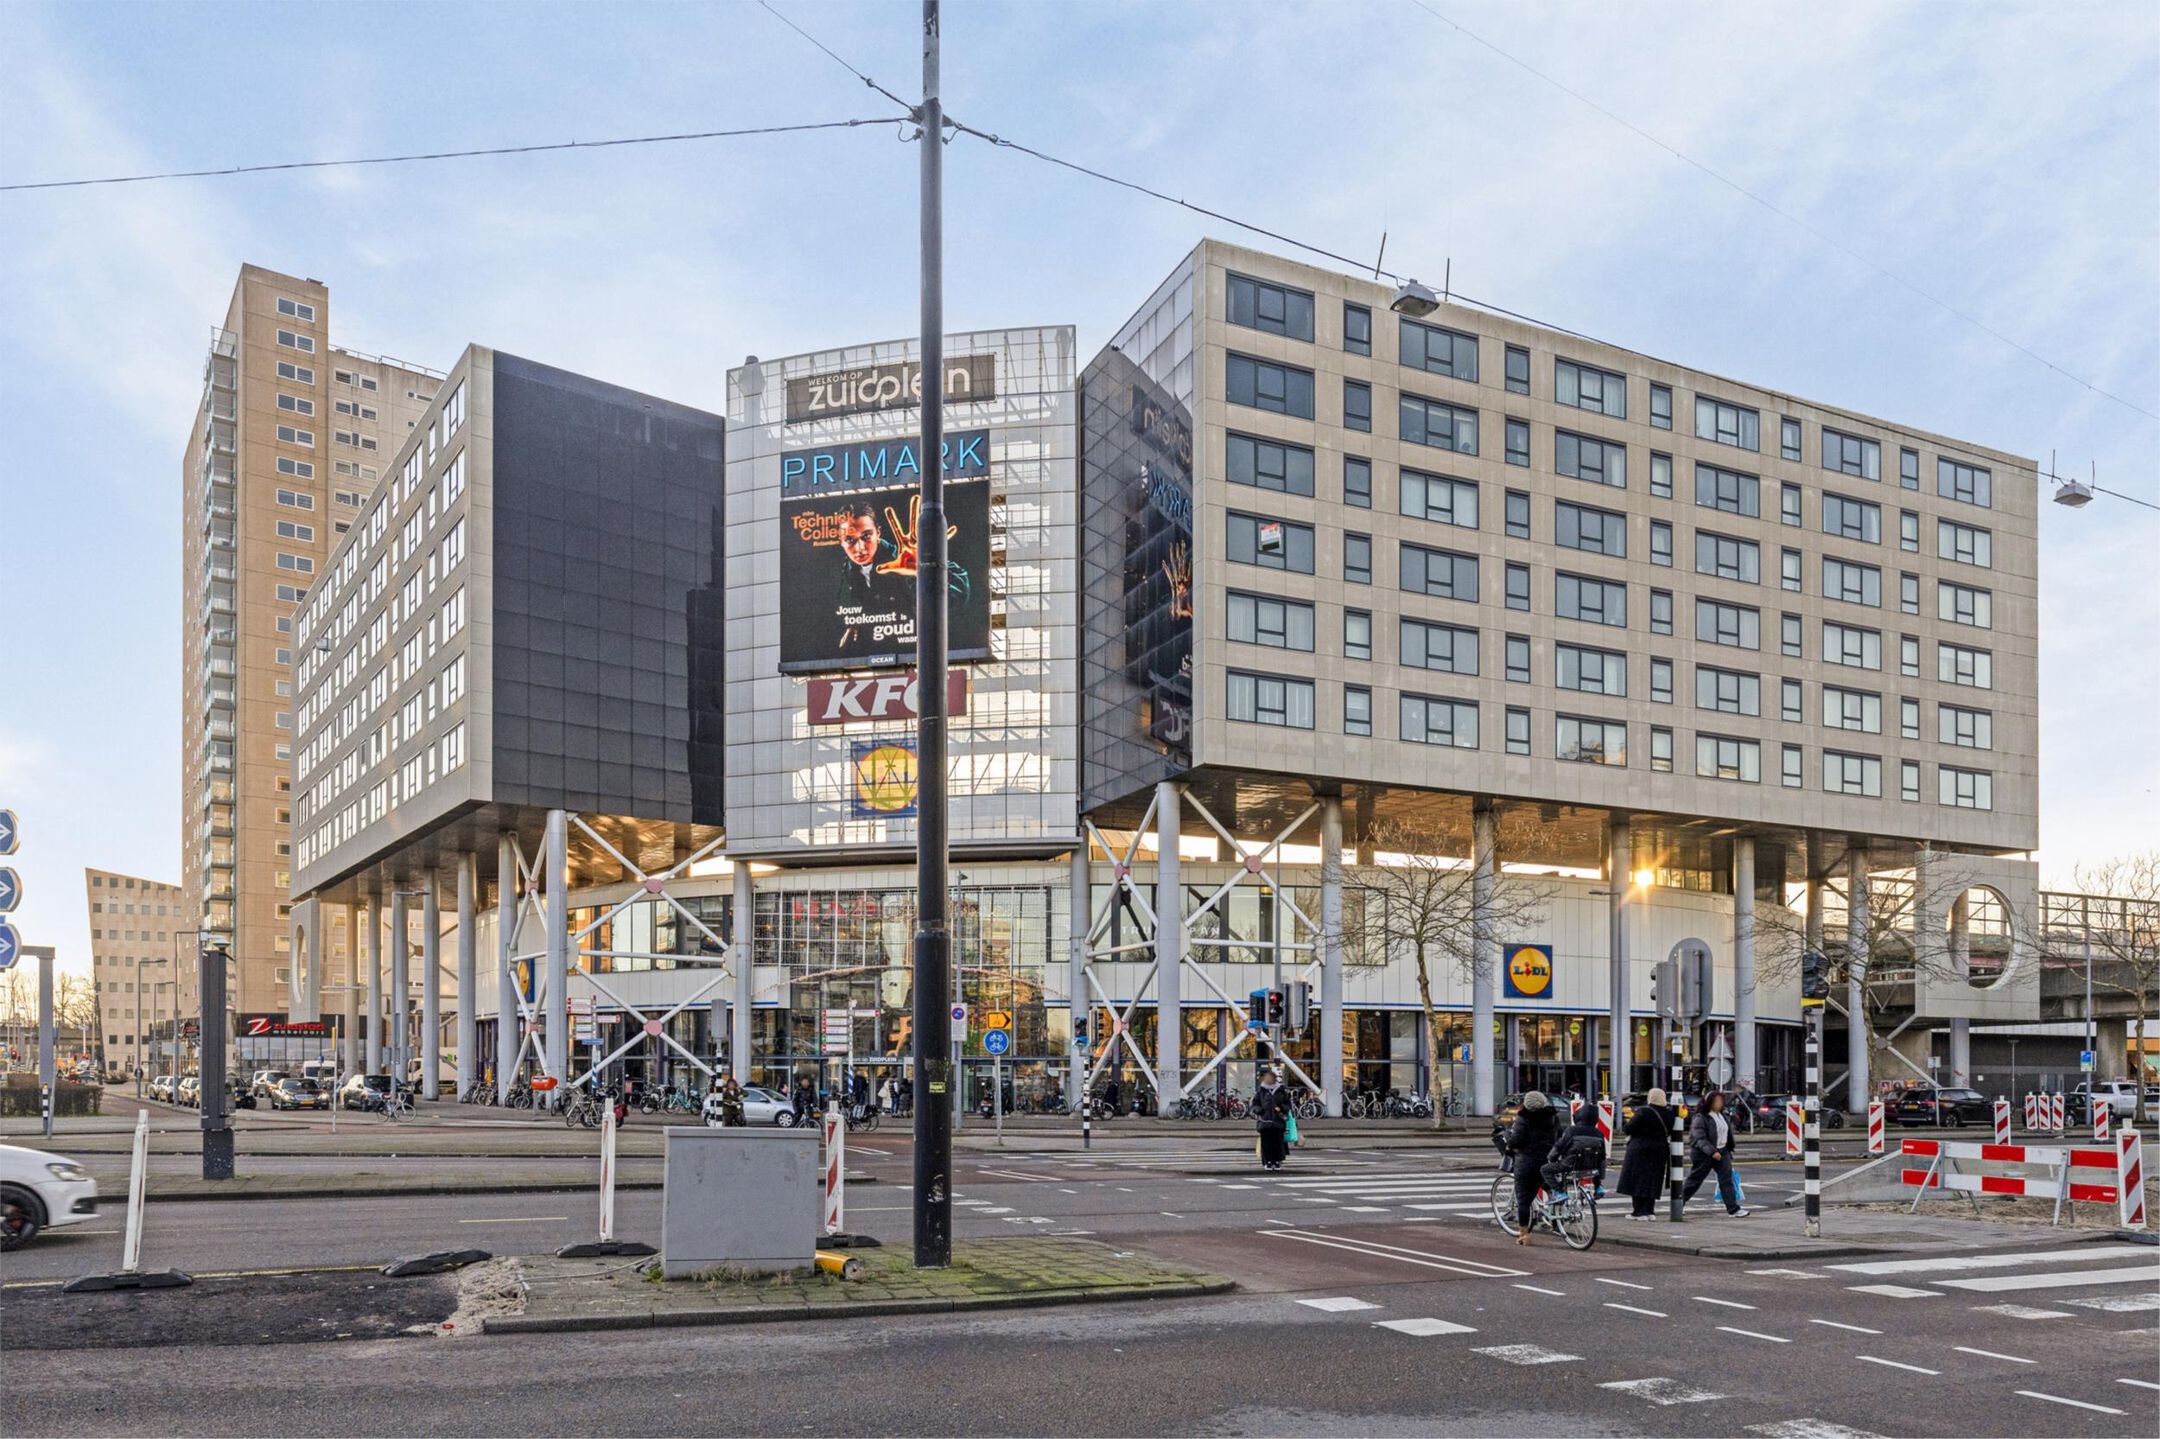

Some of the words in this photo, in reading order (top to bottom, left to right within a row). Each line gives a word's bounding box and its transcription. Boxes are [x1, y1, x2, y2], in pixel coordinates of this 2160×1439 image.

[808, 374, 847, 387] WELKOM
[850, 371, 863, 380] OP
[808, 366, 971, 411] zuidplen
[801, 527, 856, 541] College
[836, 606, 863, 616] Jouw
[844, 612, 897, 625] toekomst
[873, 619, 914, 641] goud
[897, 636, 918, 644] waar
[871, 656, 894, 664] OCEAN
